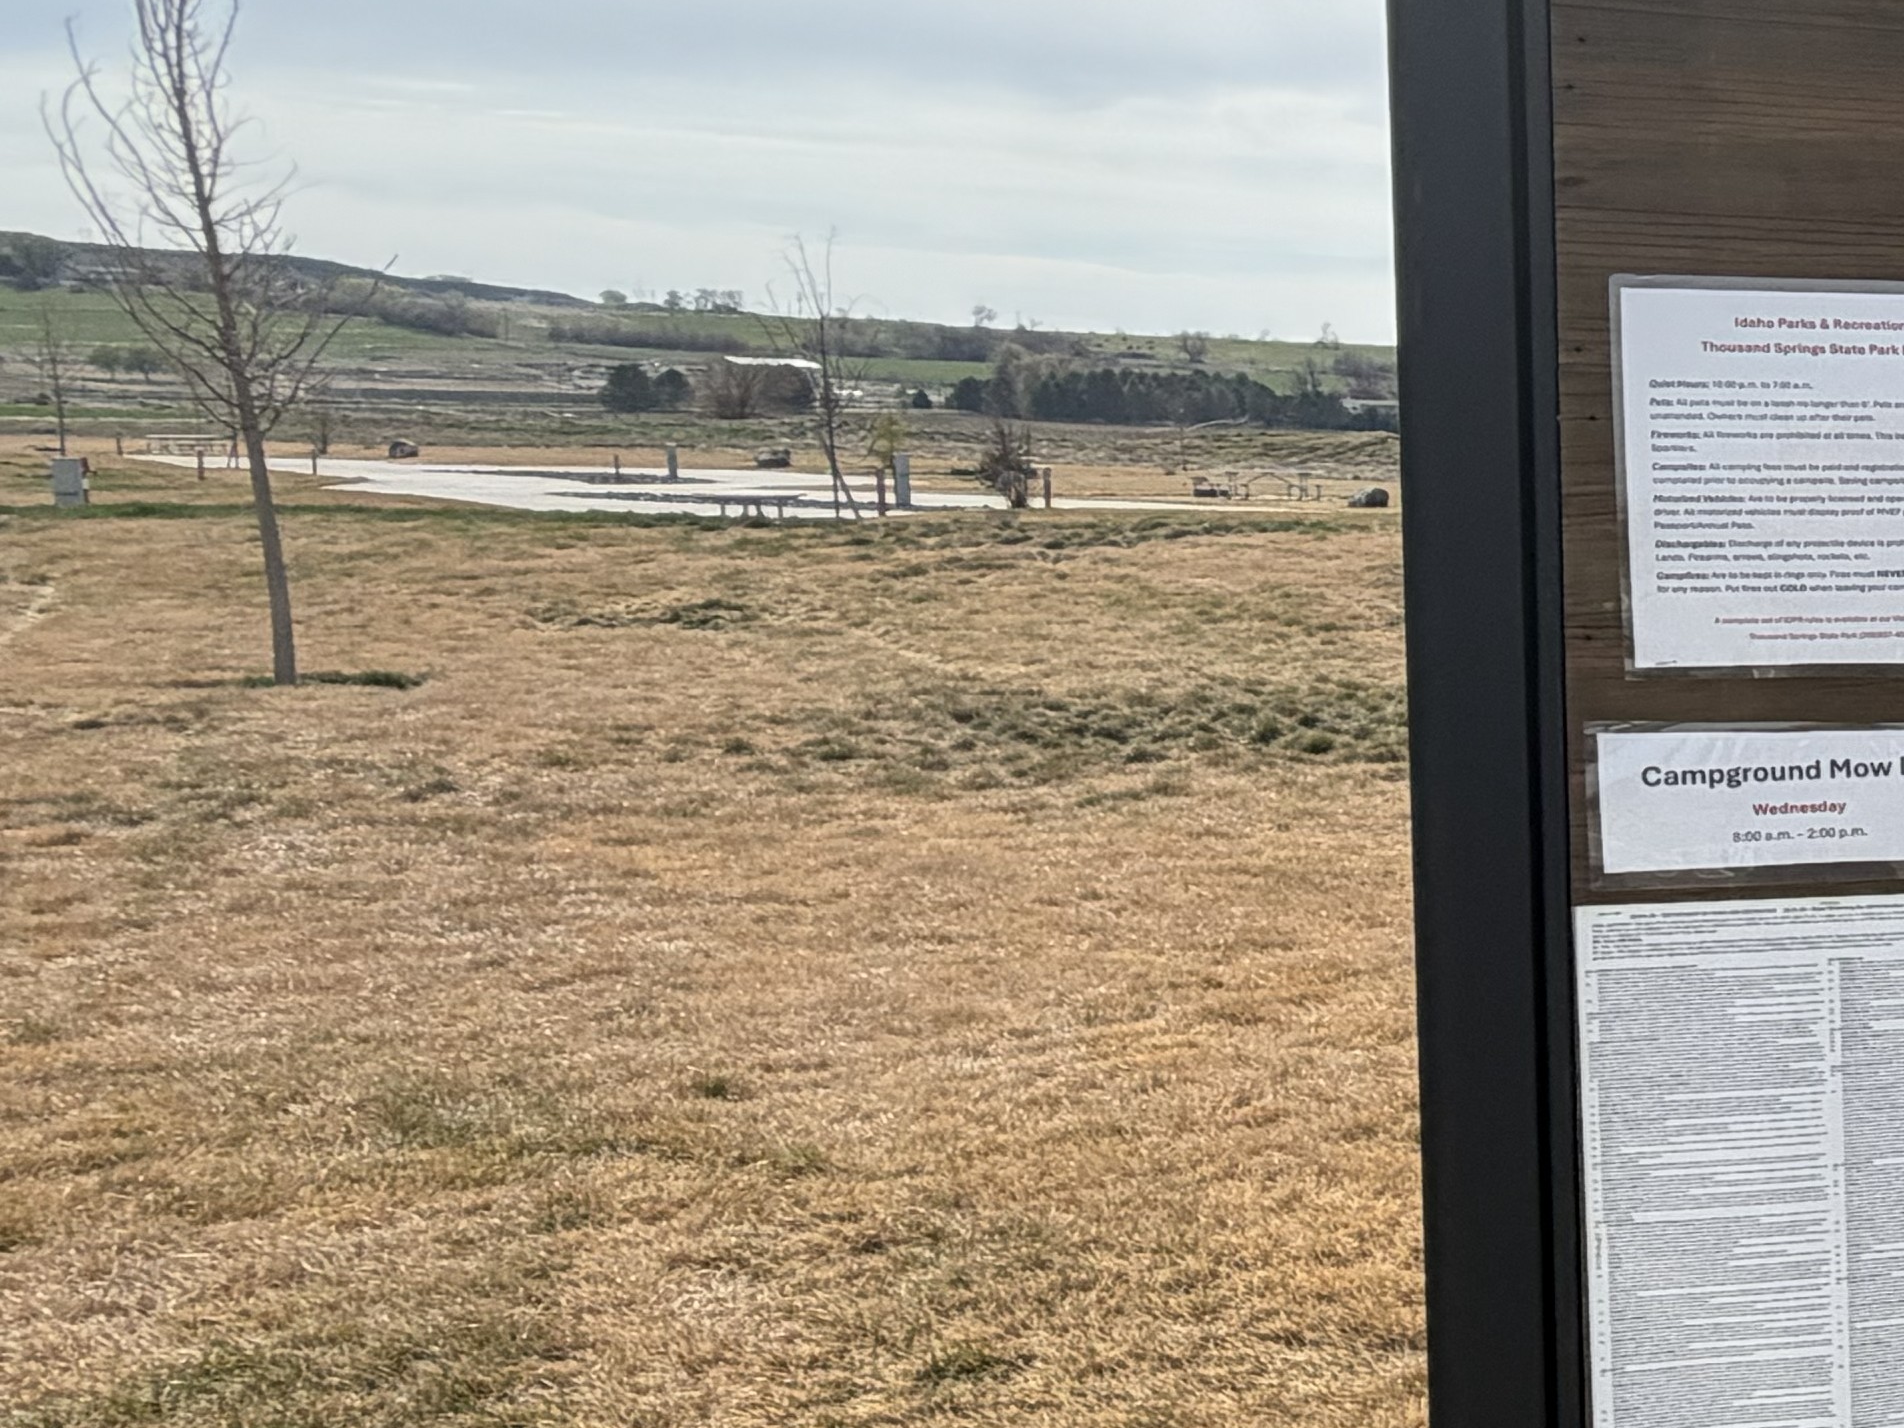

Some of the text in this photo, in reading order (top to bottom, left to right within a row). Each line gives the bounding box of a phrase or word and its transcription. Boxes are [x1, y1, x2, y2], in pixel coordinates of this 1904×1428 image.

[1734, 317, 1774, 328] Idaho
[1777, 317, 1816, 329] Parks
[1819, 318, 1829, 329] &
[1701, 341, 1770, 353] Thousand
[1773, 342, 1826, 356] Springs
[1829, 343, 1865, 355] State
[1868, 343, 1899, 355] Park
[1640, 758, 1821, 789] Campground
[1829, 758, 1892, 779] Mow
[1752, 800, 1846, 815] Wednesday
